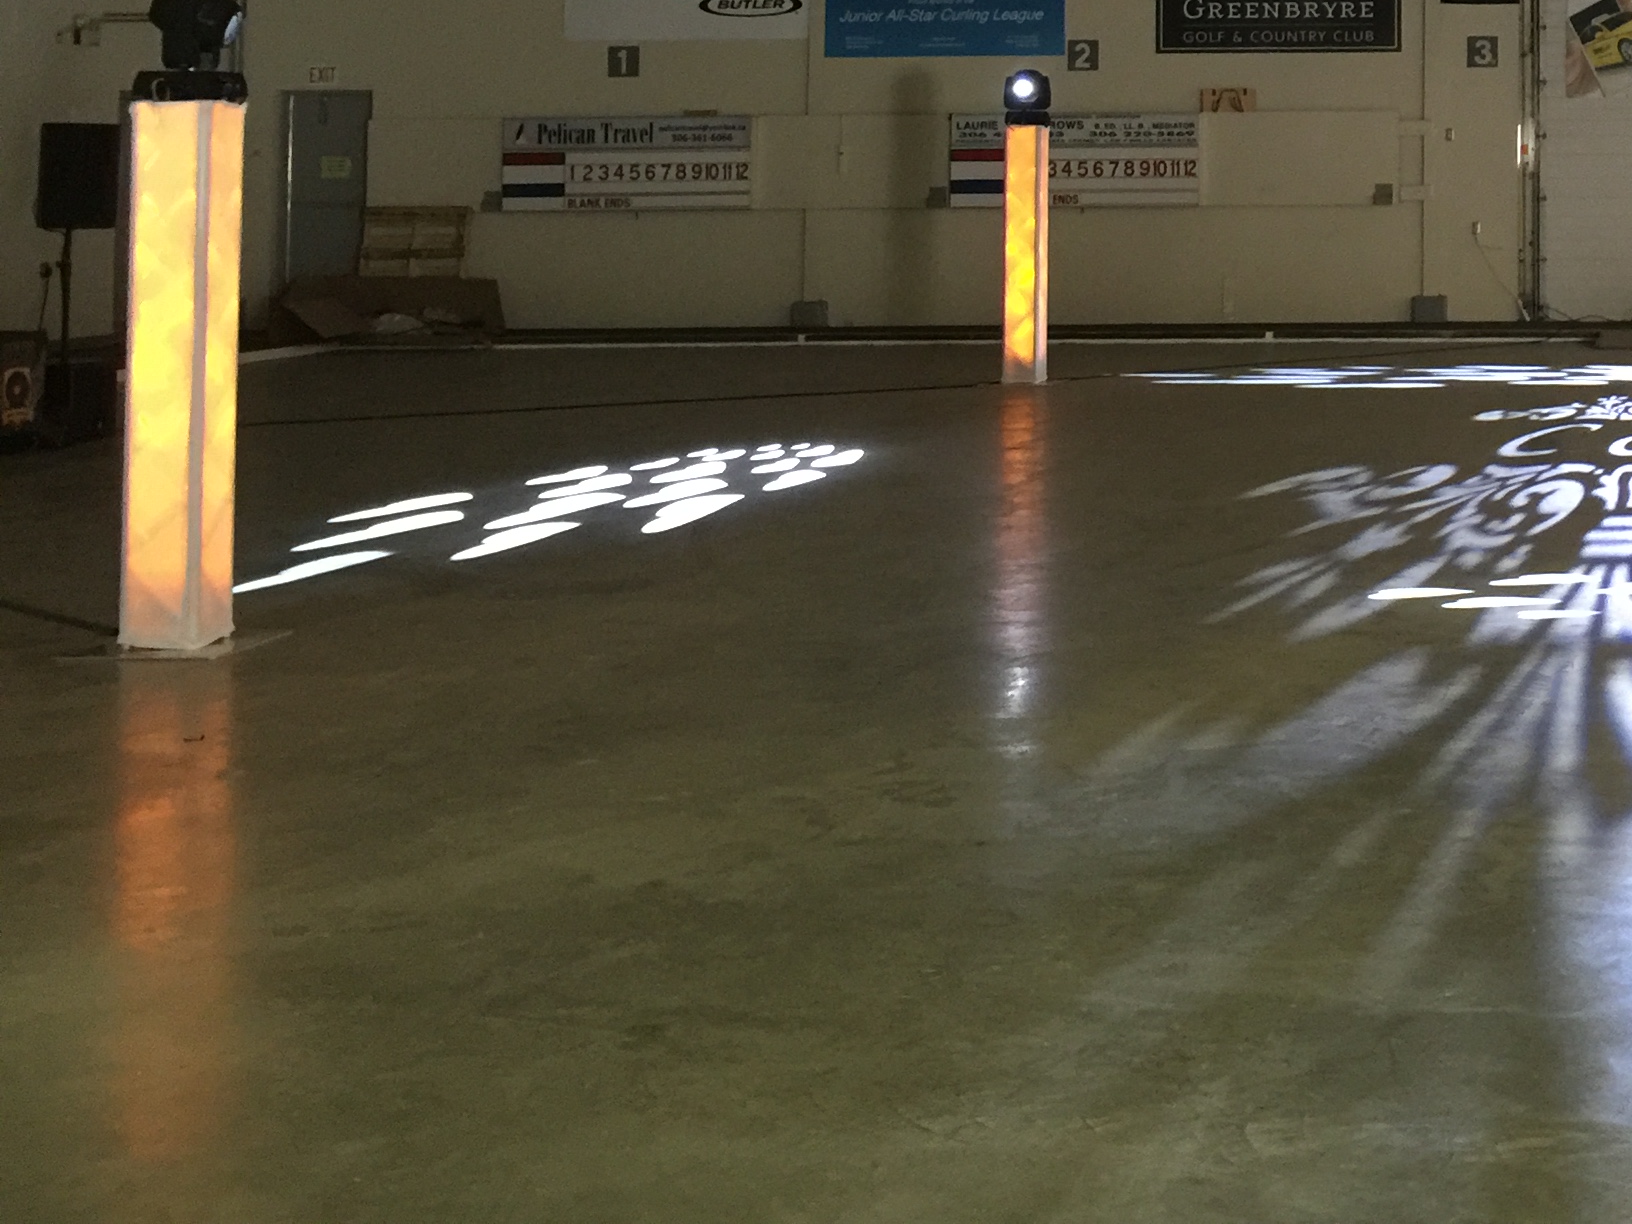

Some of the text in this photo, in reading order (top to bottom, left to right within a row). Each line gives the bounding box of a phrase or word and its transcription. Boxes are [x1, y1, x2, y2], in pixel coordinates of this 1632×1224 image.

[717, 0, 785, 10] BUTLER
[839, 8, 1044, 24] Junior All-Star Curling League
[1183, 29, 1375, 44] GOLF & COUNTRY CLUB
[1075, 44, 1090, 67] 2
[1474, 40, 1492, 65] 3
[617, 49, 627, 75] 1
[309, 66, 336, 83] EXIT
[536, 123, 596, 144] Pelican
[601, 122, 653, 144] Travel
[956, 121, 998, 130] LAURIE
[567, 198, 631, 208] BLANK ENDS
[1053, 194, 1079, 204] ENDS
[1497, 422, 1604, 457] C
